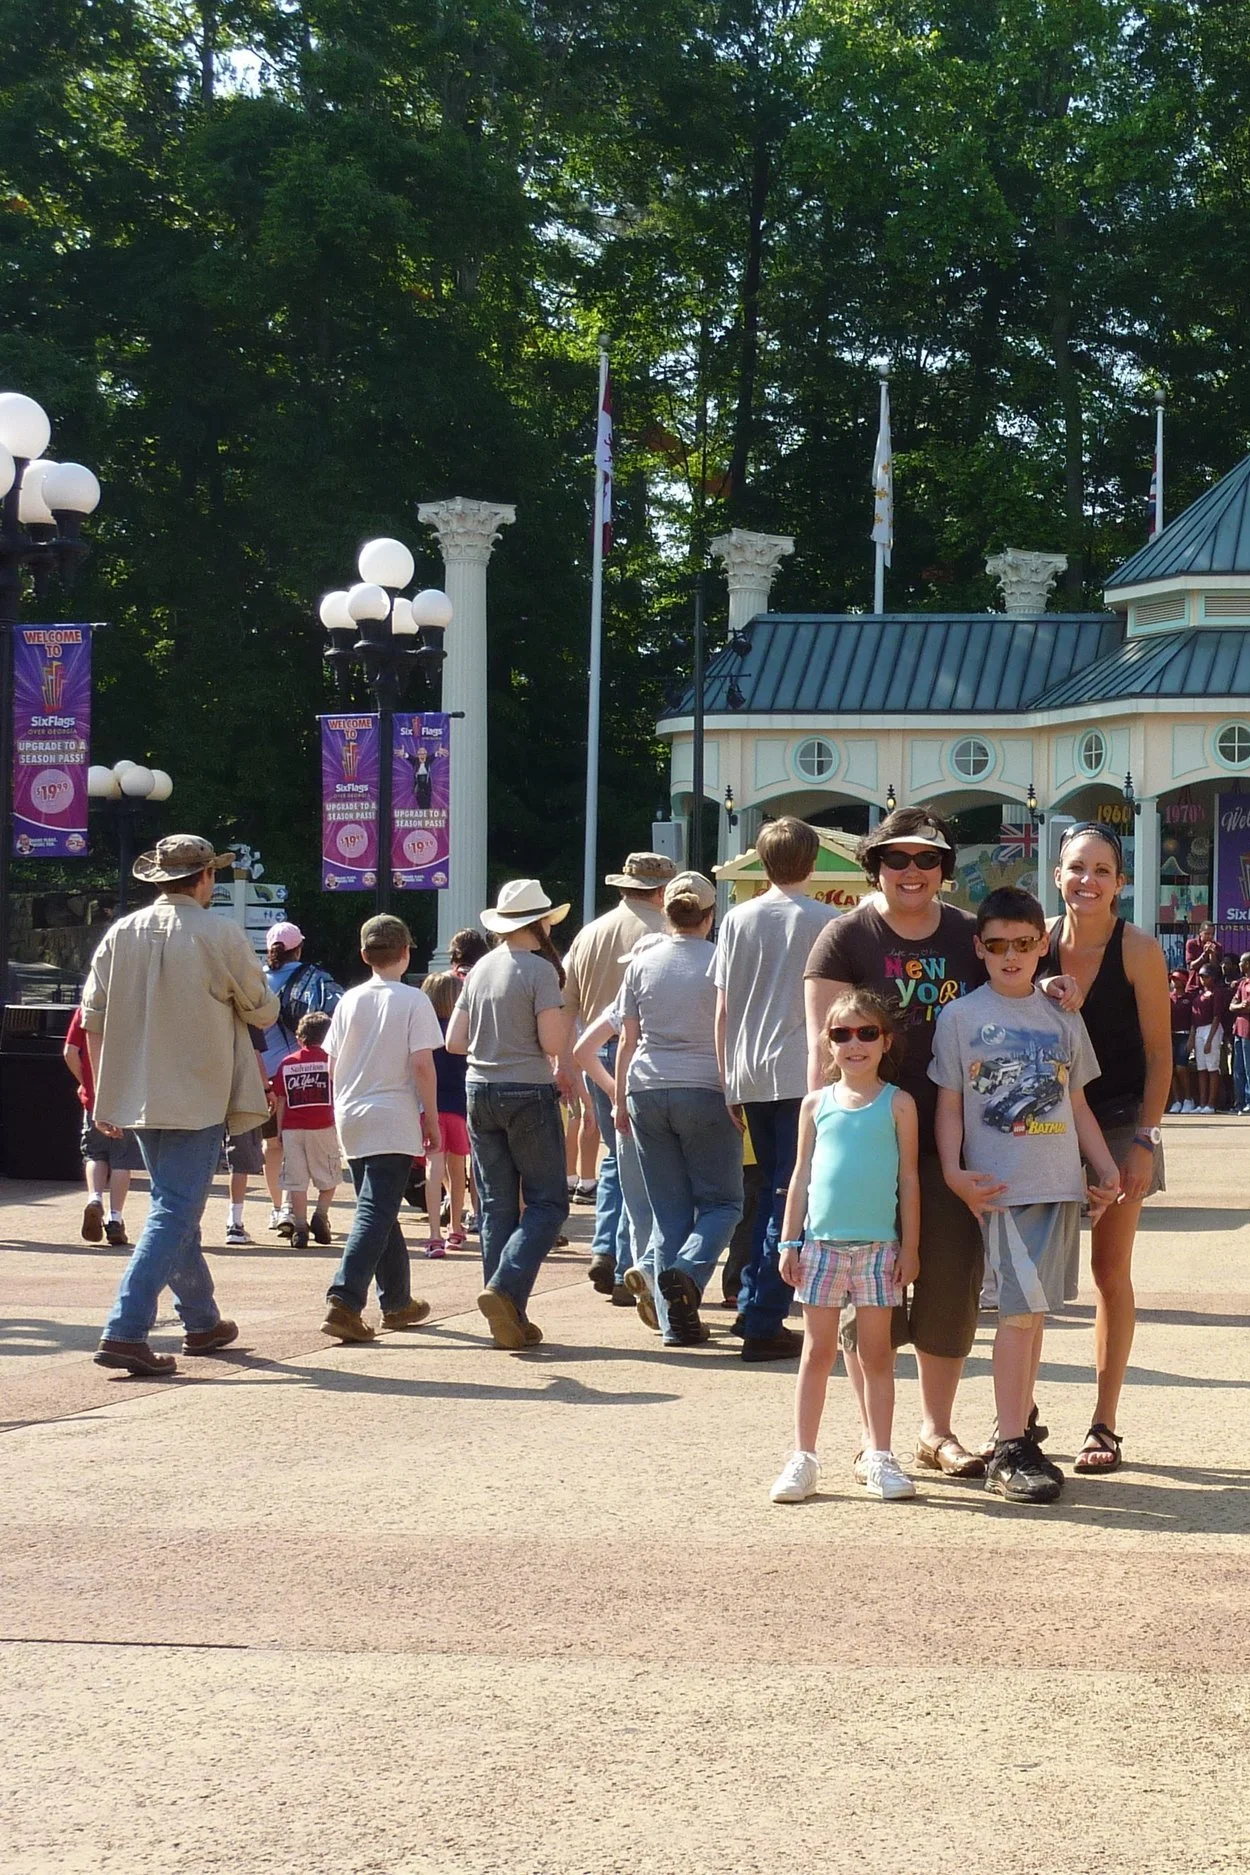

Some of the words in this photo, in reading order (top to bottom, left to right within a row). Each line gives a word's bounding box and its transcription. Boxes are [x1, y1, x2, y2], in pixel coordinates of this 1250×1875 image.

[24, 630, 82, 644] WELCOME
[45, 644, 62, 657] TO
[31, 716, 76, 727] SixFlags
[328, 718, 372, 730] WELCOME
[344, 730, 357, 740] TO
[400, 727, 413, 735] Six
[421, 727, 443, 736] Flags
[18, 741, 63, 751] UPGRADE
[65, 741, 76, 750] TO
[79, 741, 86, 750] A
[20, 754, 56, 764] SEASON
[58, 754, 84, 763] PASS!
[326, 803, 358, 811] UPGRADE
[394, 810, 427, 818] UPGRADE
[429, 810, 439, 818] TO
[441, 810, 447, 818] A
